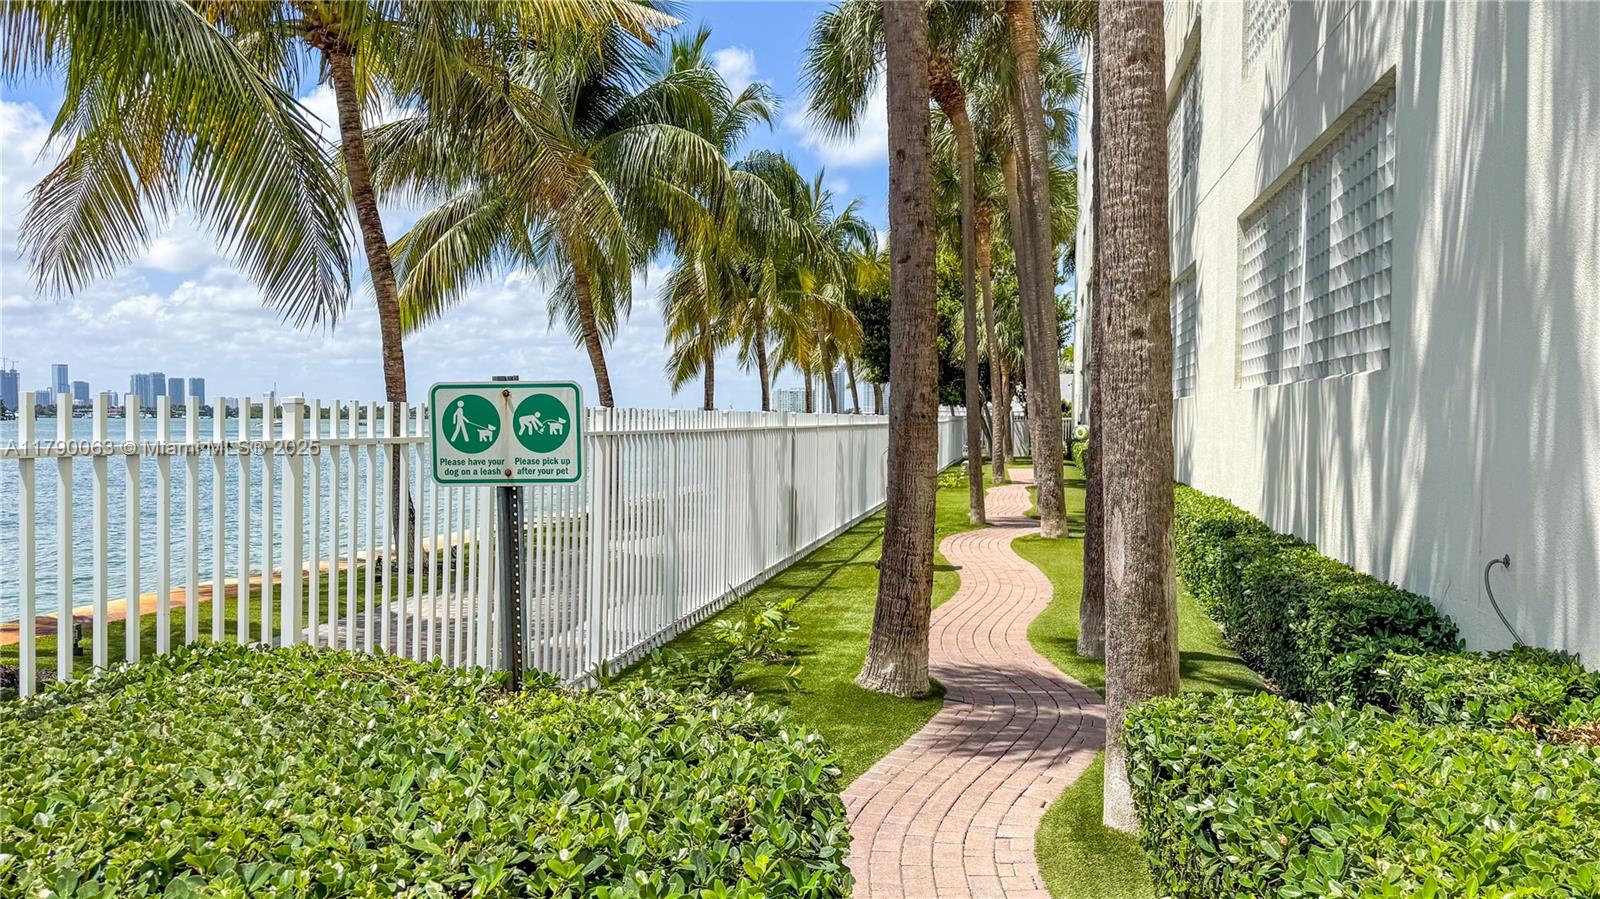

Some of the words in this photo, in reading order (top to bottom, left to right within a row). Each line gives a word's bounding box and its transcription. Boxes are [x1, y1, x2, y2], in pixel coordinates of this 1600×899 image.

[439, 457, 466, 466] Please
[467, 457, 486, 466] have
[487, 459, 505, 467] your
[514, 457, 541, 465] Please
[542, 457, 559, 466] pick
[560, 458, 571, 466] up
[444, 468, 459, 477] dog
[480, 468, 502, 476] leash
[516, 467, 536, 475] after
[537, 468, 555, 476] your
[556, 467, 569, 476] pet
